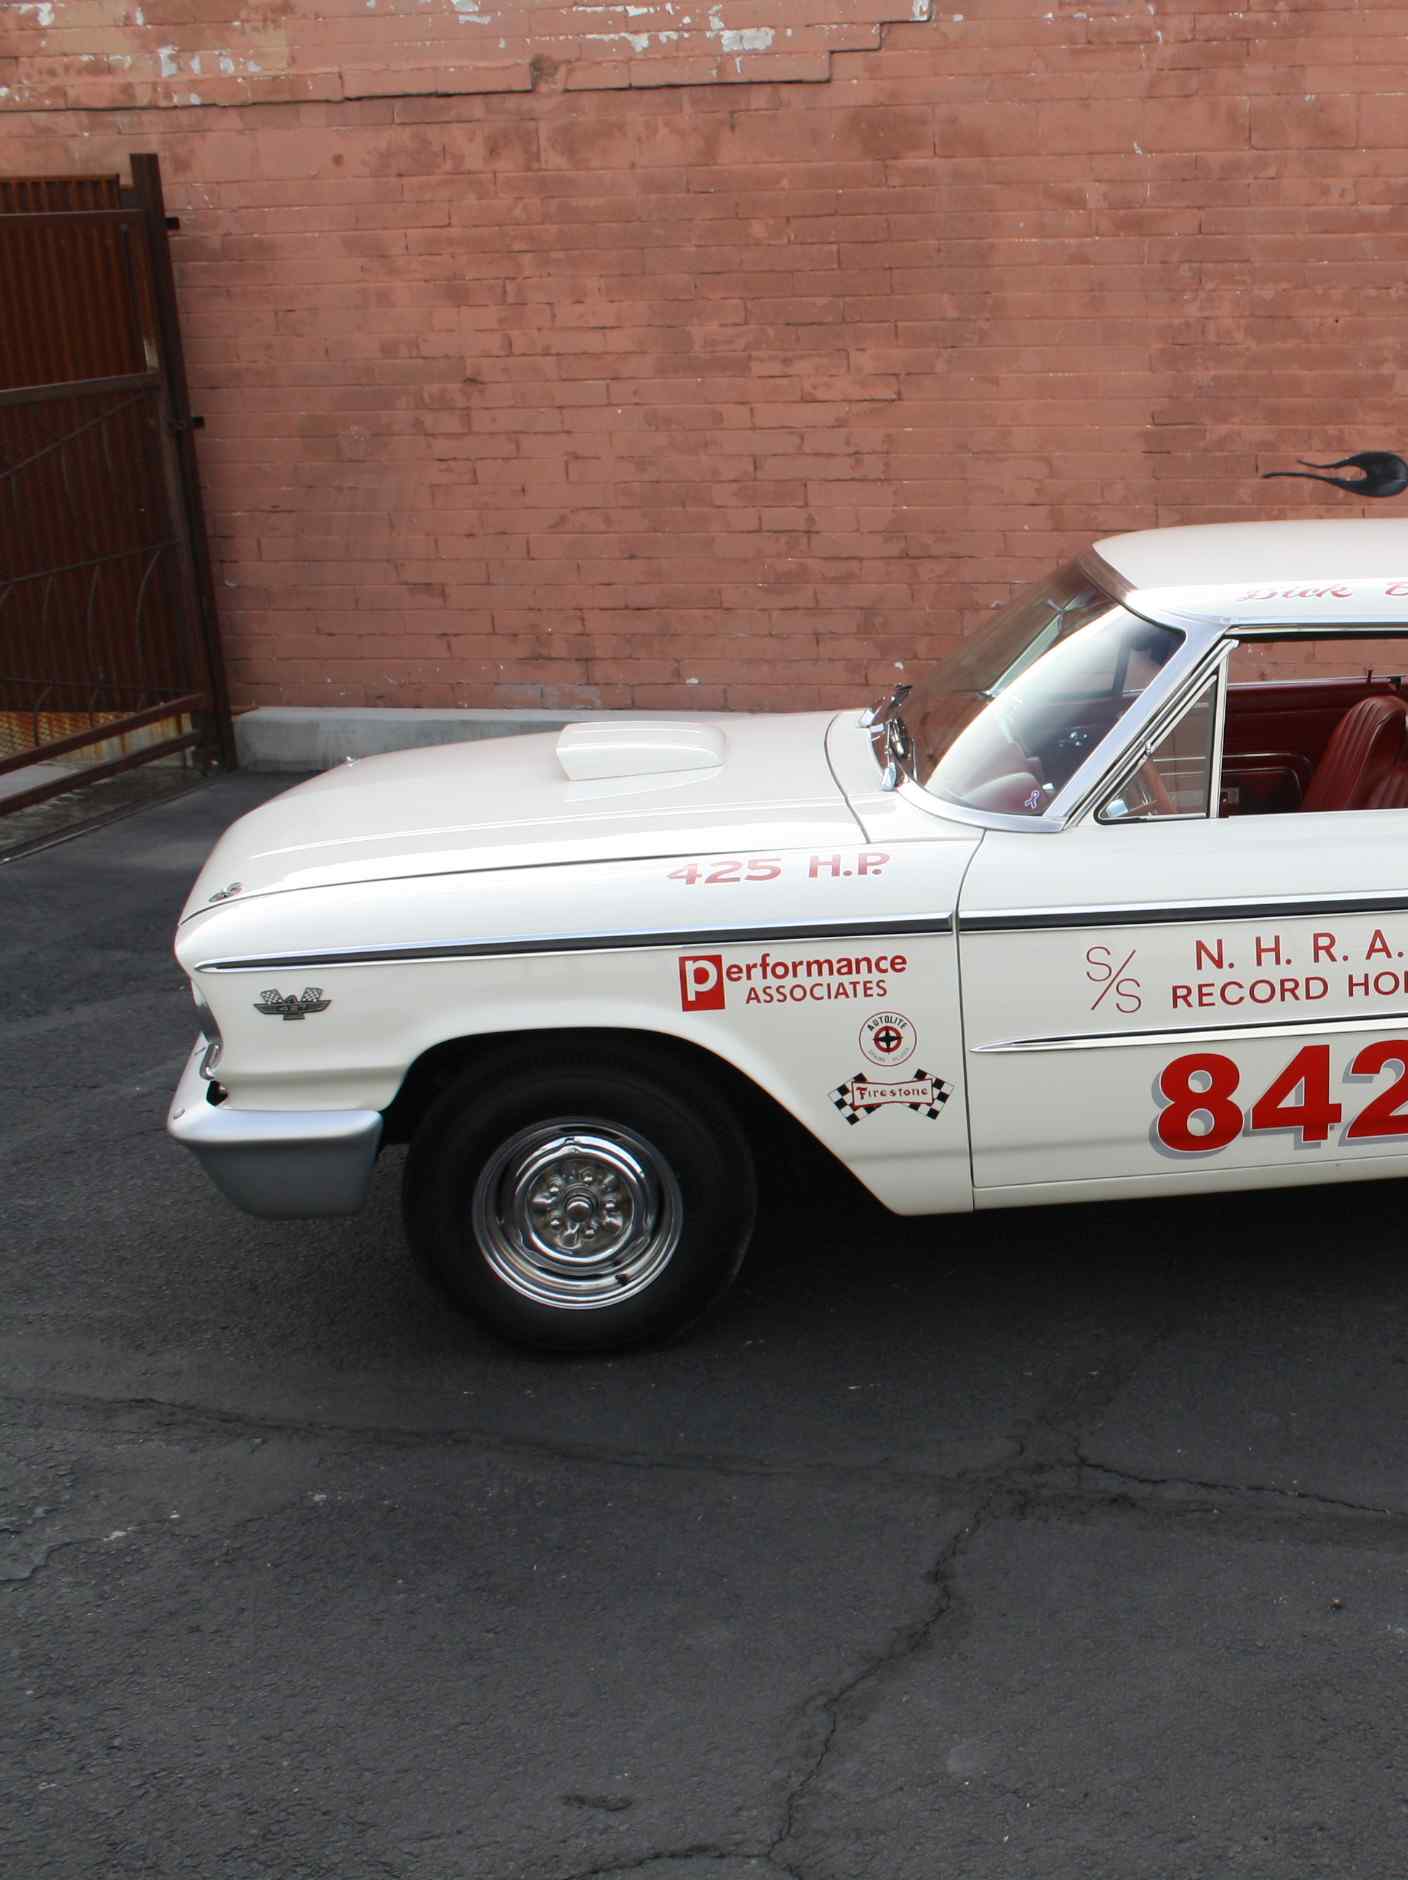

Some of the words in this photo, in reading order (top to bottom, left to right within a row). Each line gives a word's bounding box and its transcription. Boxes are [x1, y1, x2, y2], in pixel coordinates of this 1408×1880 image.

[1237, 580, 1353, 601] Dick
[667, 857, 782, 886] 425
[808, 852, 890, 879] H.P.
[745, 979, 888, 1005] ASSOCIATES
[1171, 976, 1329, 1009] RECORD
[867, 1014, 908, 1032] AUTOLITE
[855, 1086, 929, 1100] Firestone
